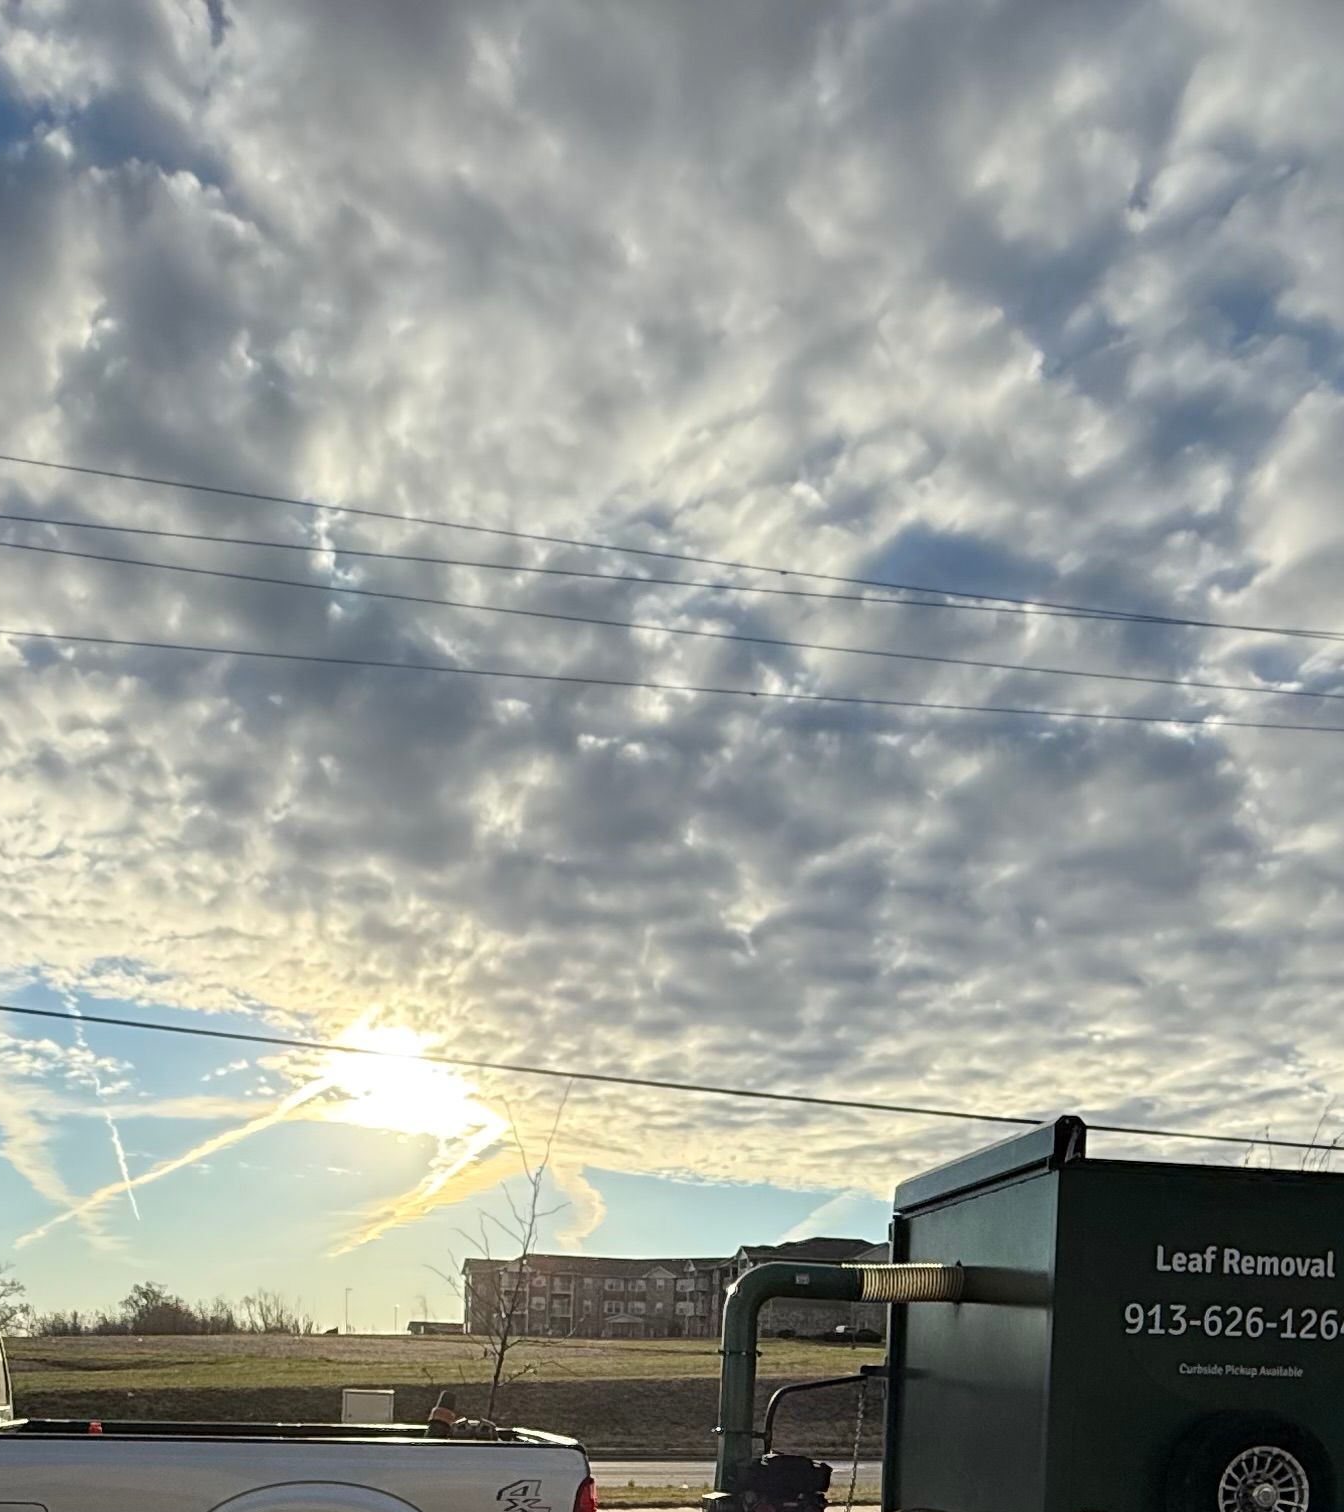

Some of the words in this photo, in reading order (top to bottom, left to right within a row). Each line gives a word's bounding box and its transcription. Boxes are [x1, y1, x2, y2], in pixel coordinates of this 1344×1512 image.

[1156, 1244, 1218, 1273] Leaf
[1222, 1248, 1336, 1278] Removal
[1179, 1362, 1224, 1376] Curbside
[1225, 1364, 1258, 1378] Pickup
[1259, 1365, 1304, 1378] Available
